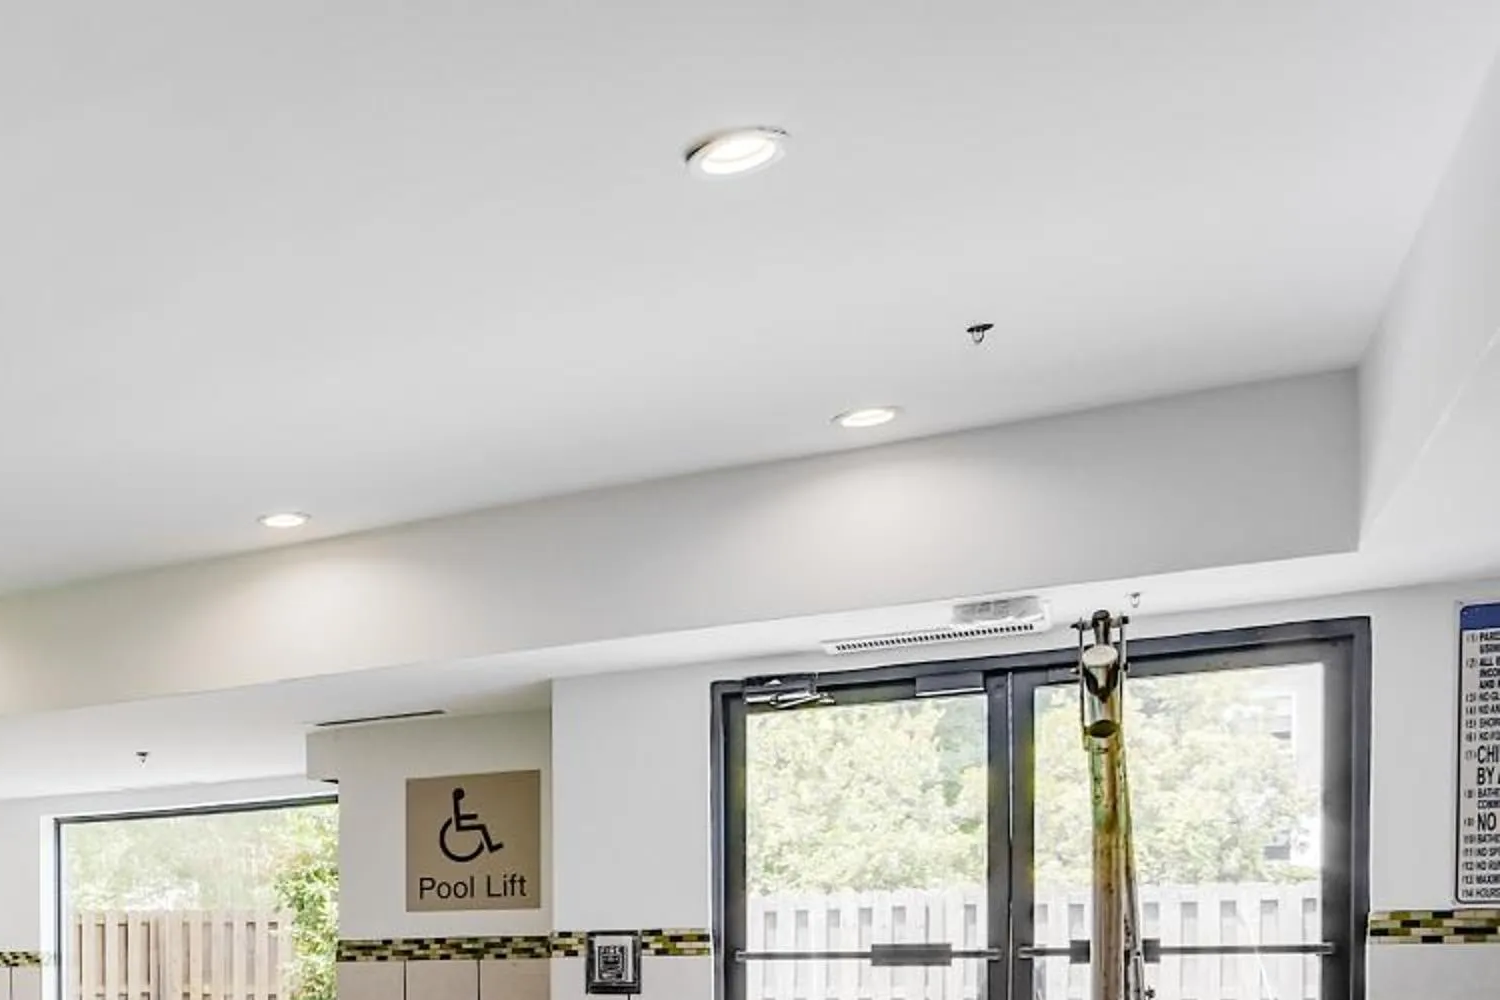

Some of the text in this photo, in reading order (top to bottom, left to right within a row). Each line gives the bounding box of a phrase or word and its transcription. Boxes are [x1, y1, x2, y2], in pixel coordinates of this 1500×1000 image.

[1477, 766, 1495, 785] BY
[1477, 811, 1497, 832] NO
[419, 873, 527, 900] Pool Lift
